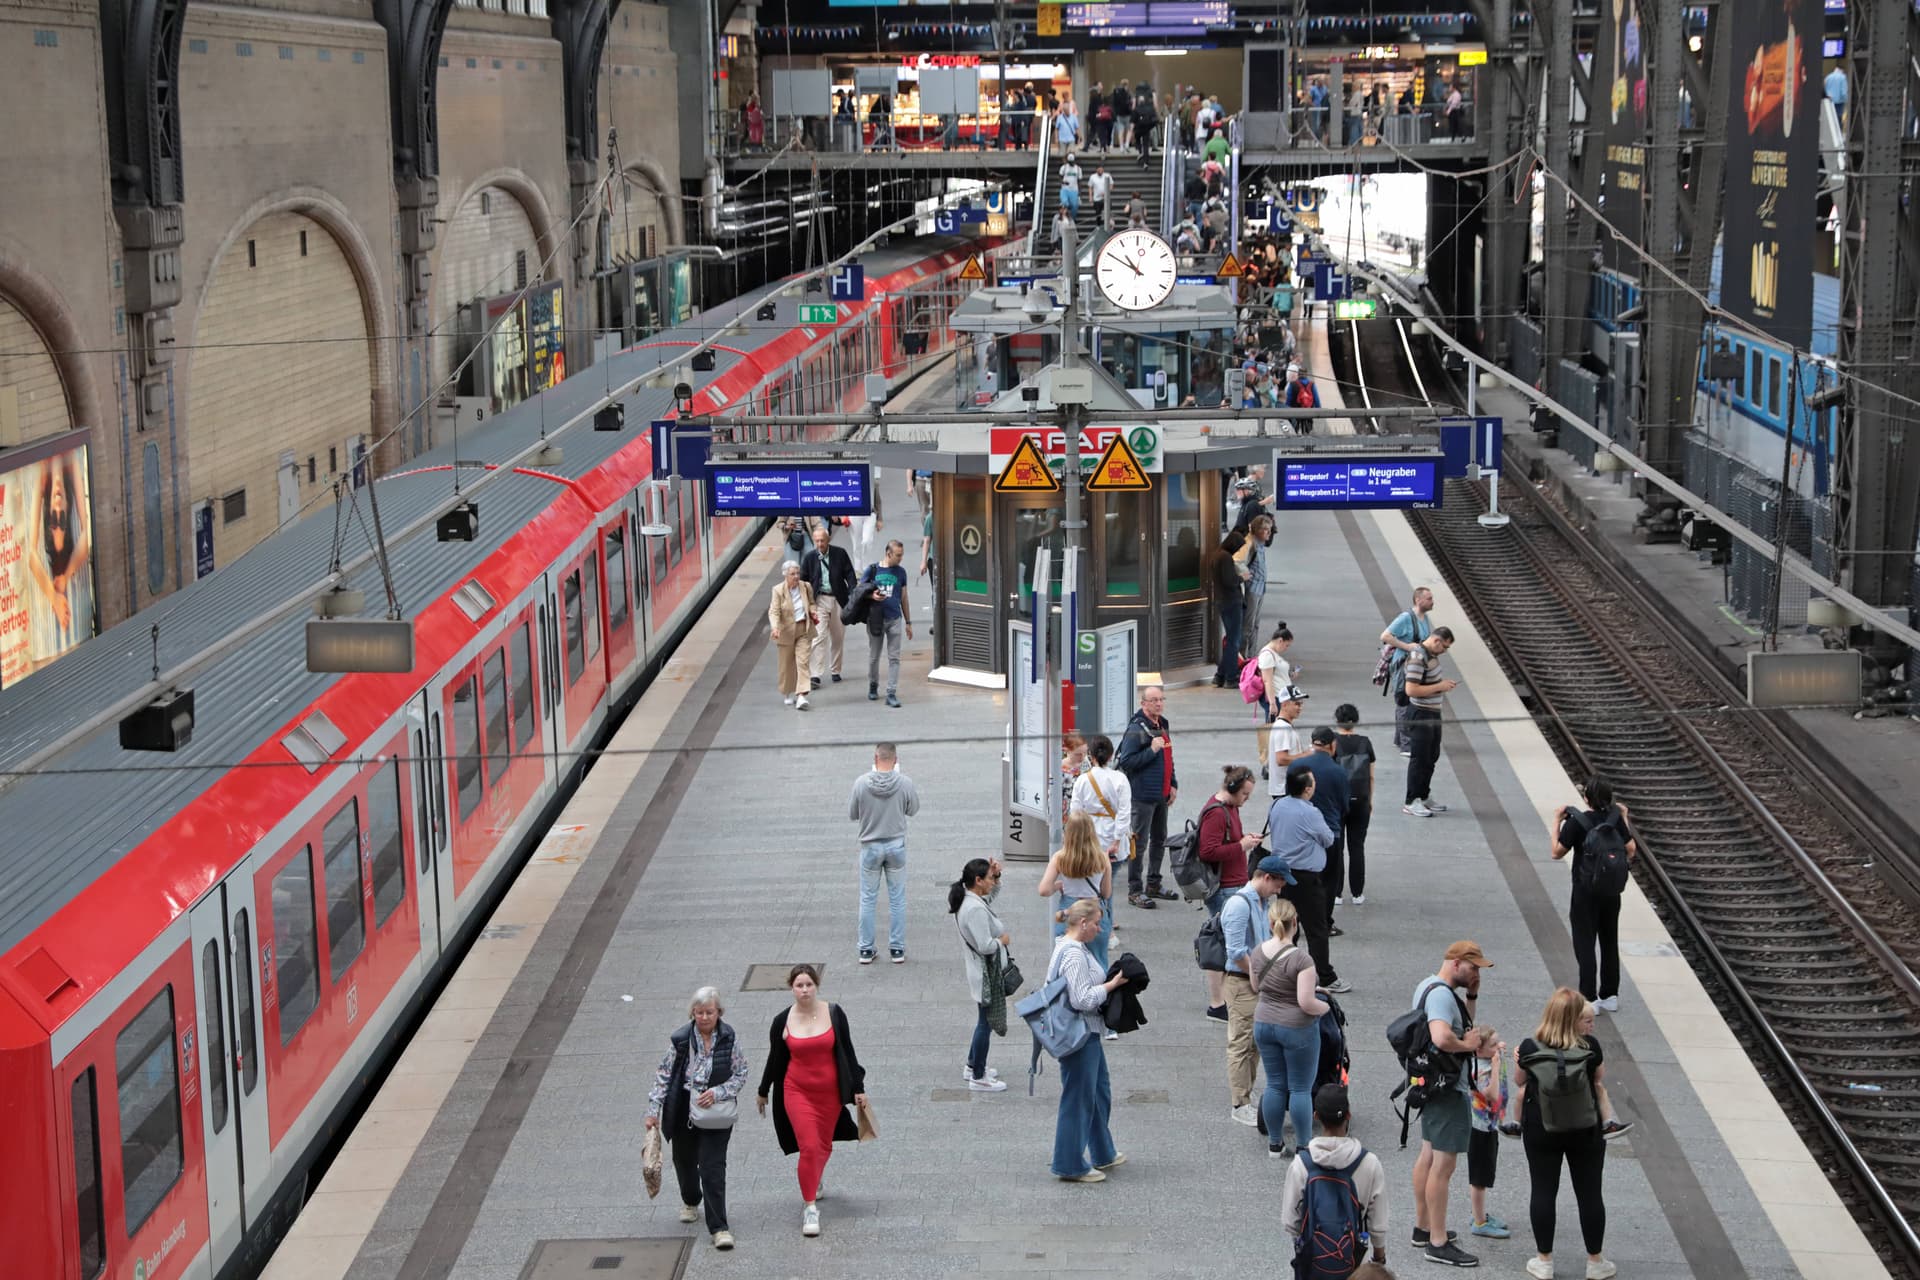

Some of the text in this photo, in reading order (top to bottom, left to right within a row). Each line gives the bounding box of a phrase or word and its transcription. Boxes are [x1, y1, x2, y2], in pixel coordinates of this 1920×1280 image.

[931, 55, 980, 67] CROBAG
[1297, 189, 1316, 213] U
[937, 211, 953, 232] G
[832, 267, 852, 297] H
[1327, 266, 1346, 298] H
[476, 407, 484, 421] 9
[1300, 473, 1329, 482] Bergedorf
[1368, 467, 1416, 478] Neugraben
[813, 495, 845, 504] Neugraben
[1300, 489, 1331, 498] Neugraben
[0, 587, 18, 612] arif-
[1080, 633, 1096, 652] S
